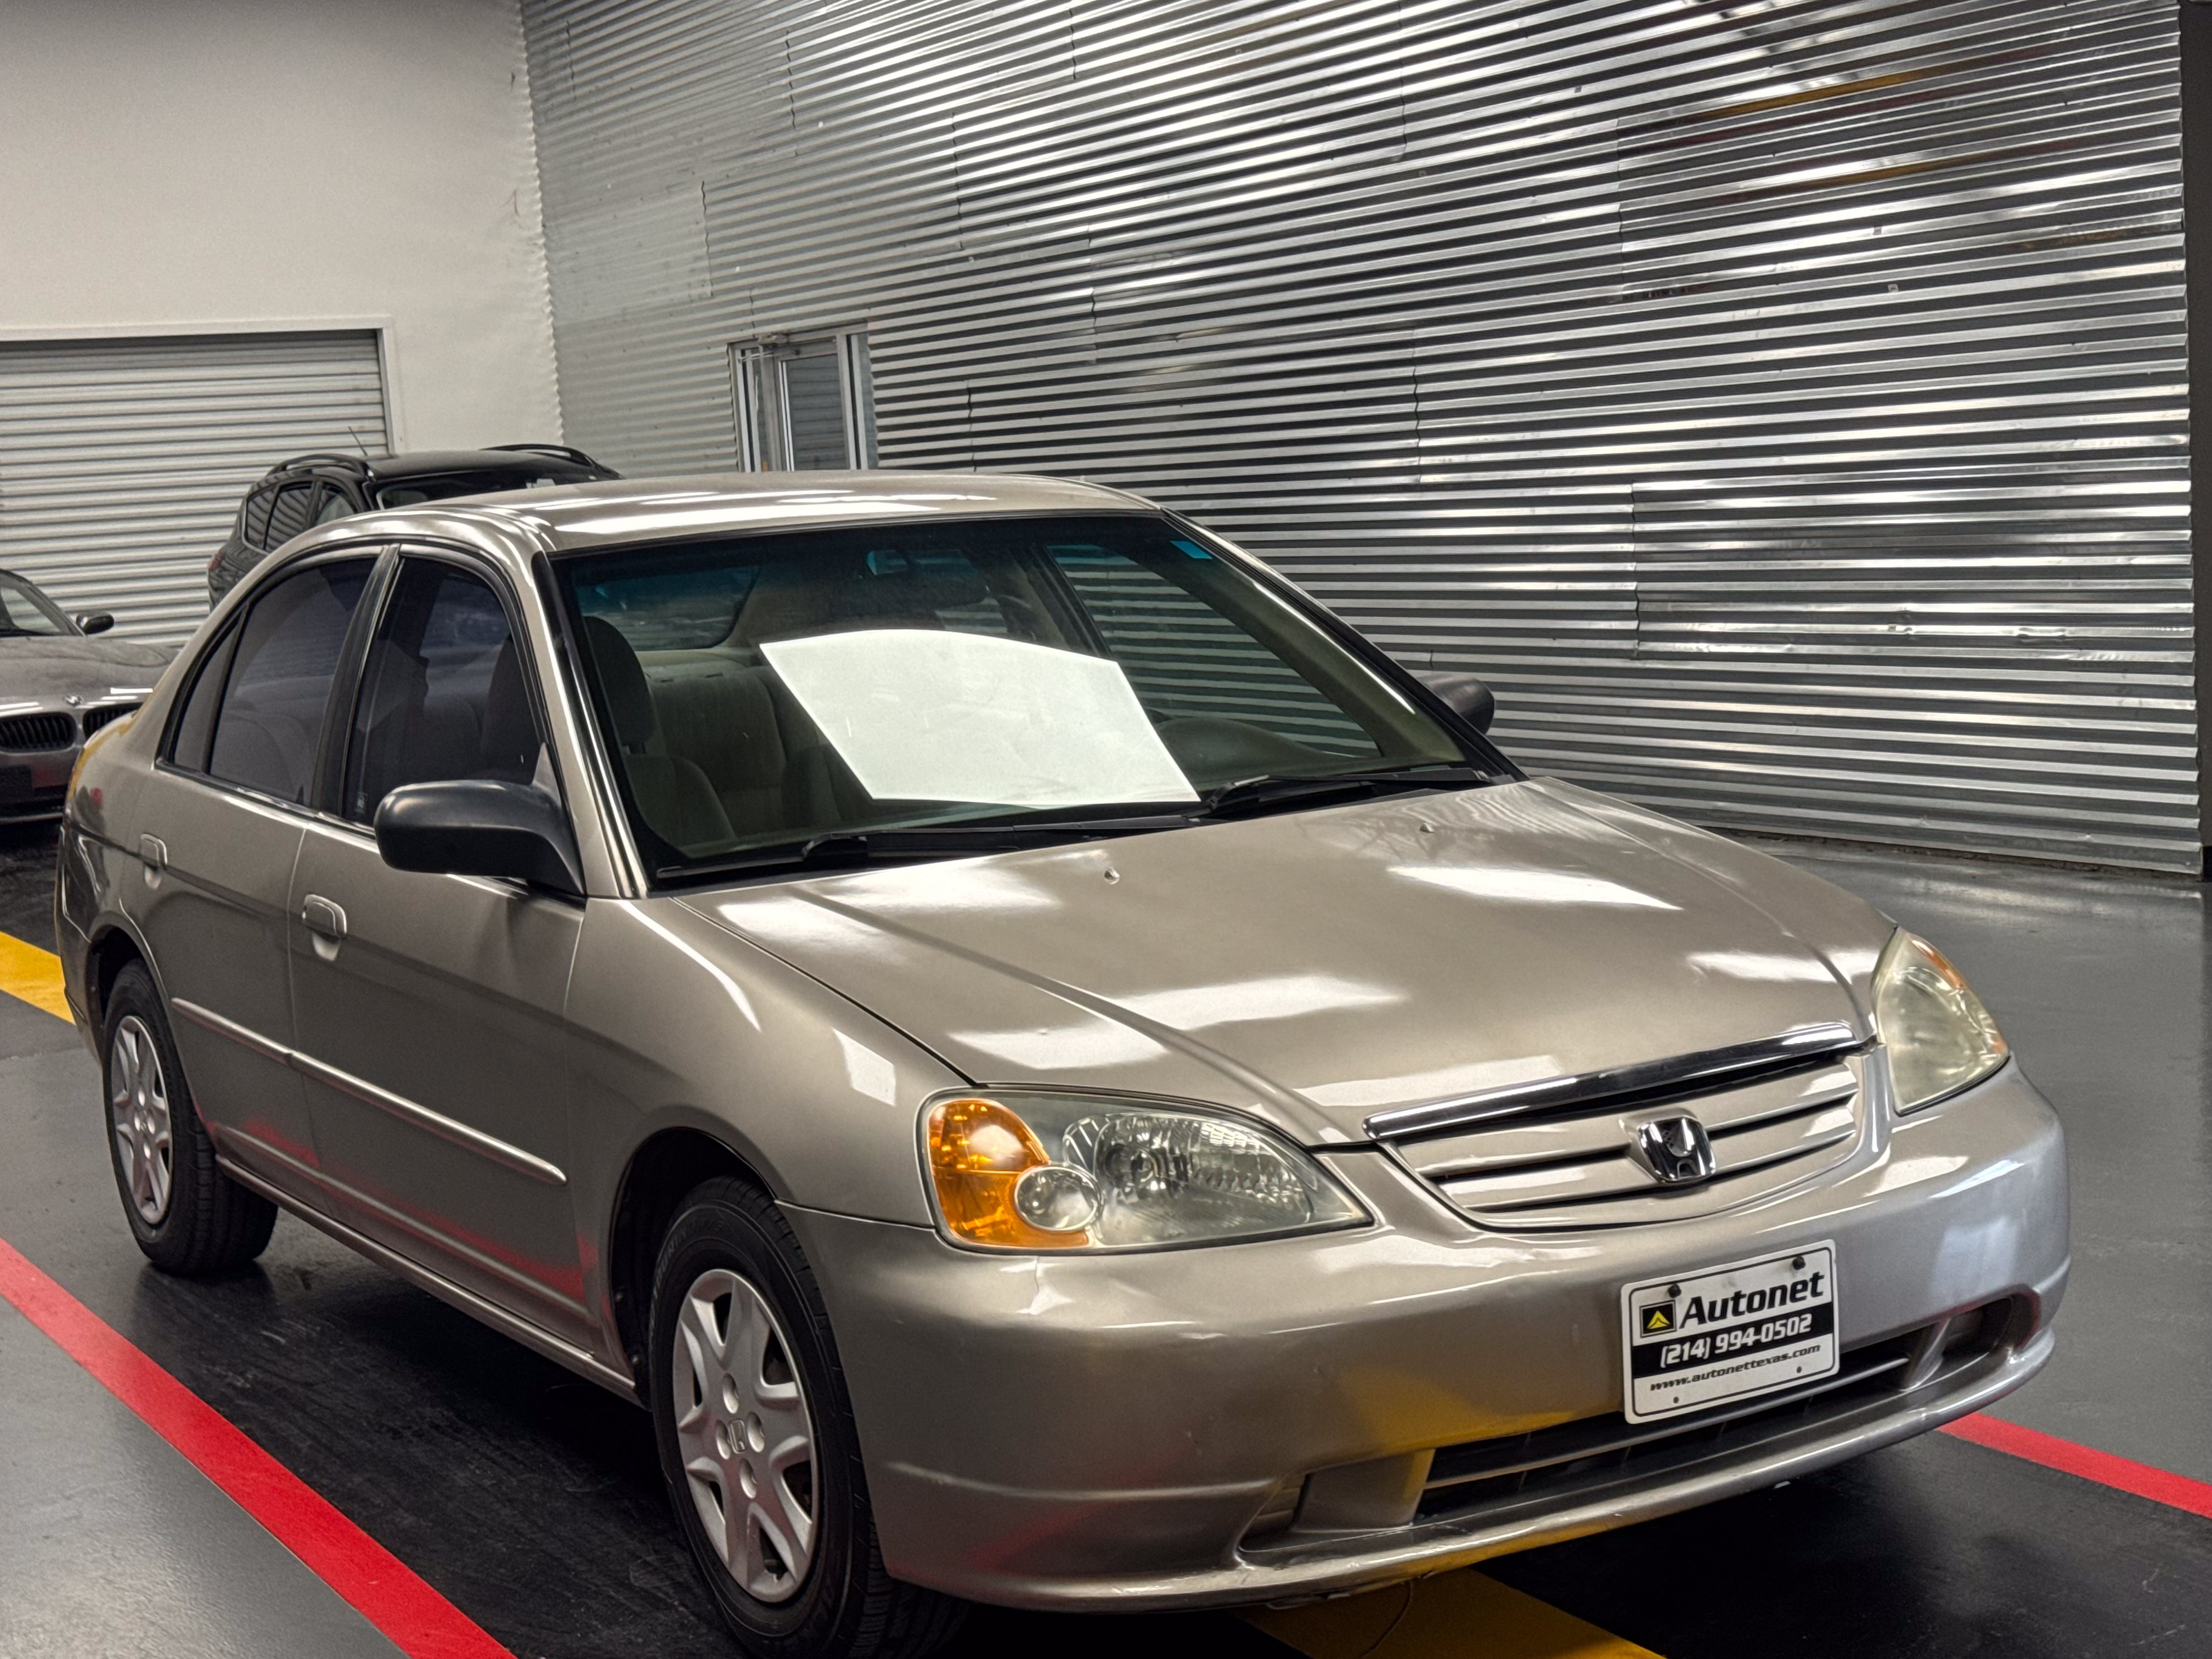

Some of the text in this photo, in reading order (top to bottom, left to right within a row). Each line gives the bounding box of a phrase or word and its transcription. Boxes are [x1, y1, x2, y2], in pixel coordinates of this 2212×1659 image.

[1679, 1272, 1825, 1330] Autonet
[1650, 1344, 1821, 1391] www.autonettexas.com
[1660, 1313, 1812, 1368] (214) 994-0502
